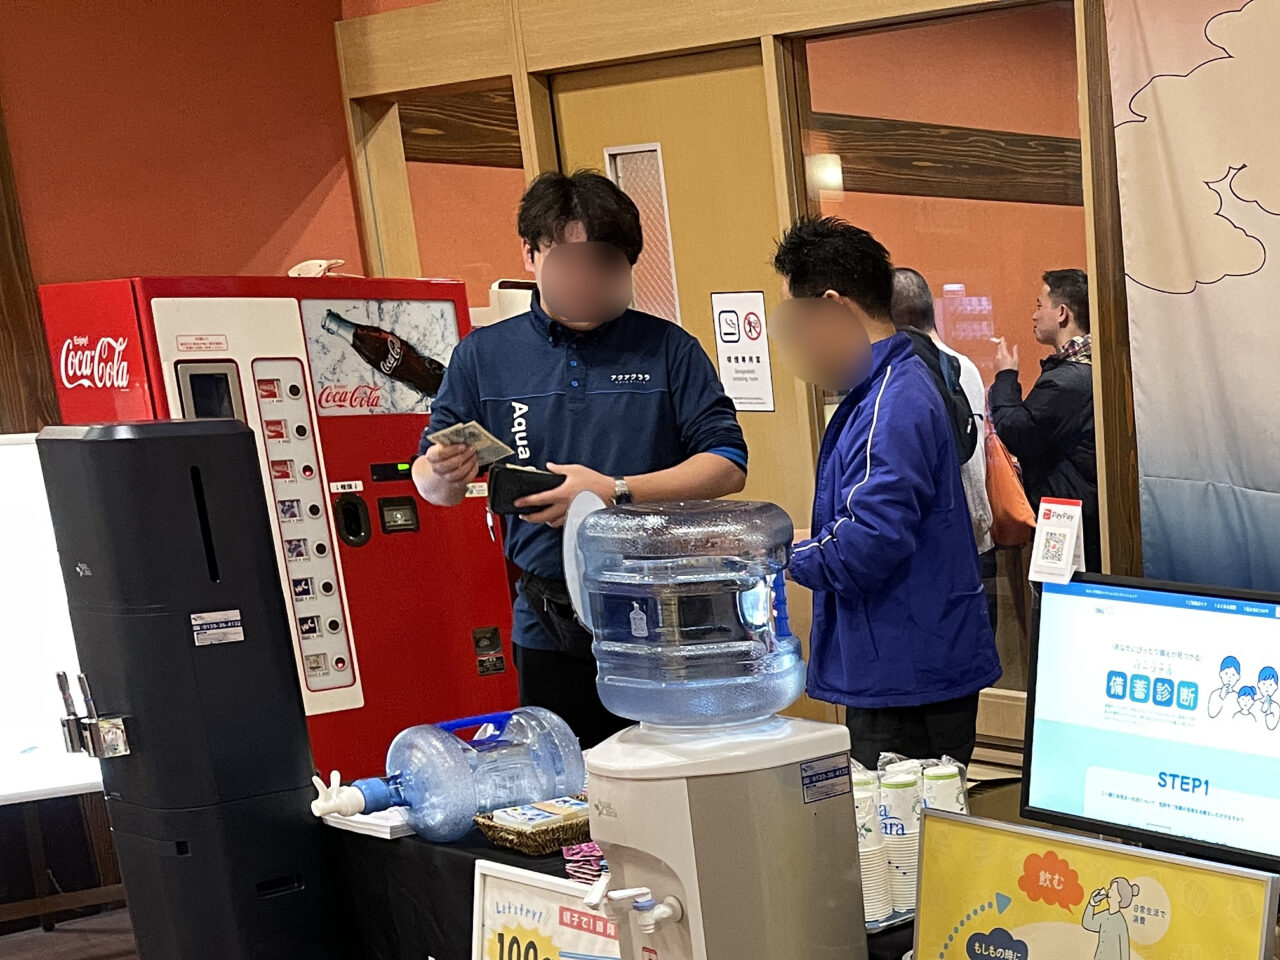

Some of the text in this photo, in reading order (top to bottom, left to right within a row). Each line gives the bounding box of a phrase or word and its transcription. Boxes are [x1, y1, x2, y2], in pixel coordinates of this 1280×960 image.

[73, 336, 88, 346] Enjoy!
[60, 337, 130, 389] Coca-Cola
[511, 401, 531, 460] Aqua
[1051, 511, 1075, 522] PayPay
[1108, 675, 1197, 709] 備蓄診断
[1158, 772, 1209, 796] STEP1
[1038, 870, 1064, 890] 飲む
[1132, 903, 1167, 919] 日常生活で
